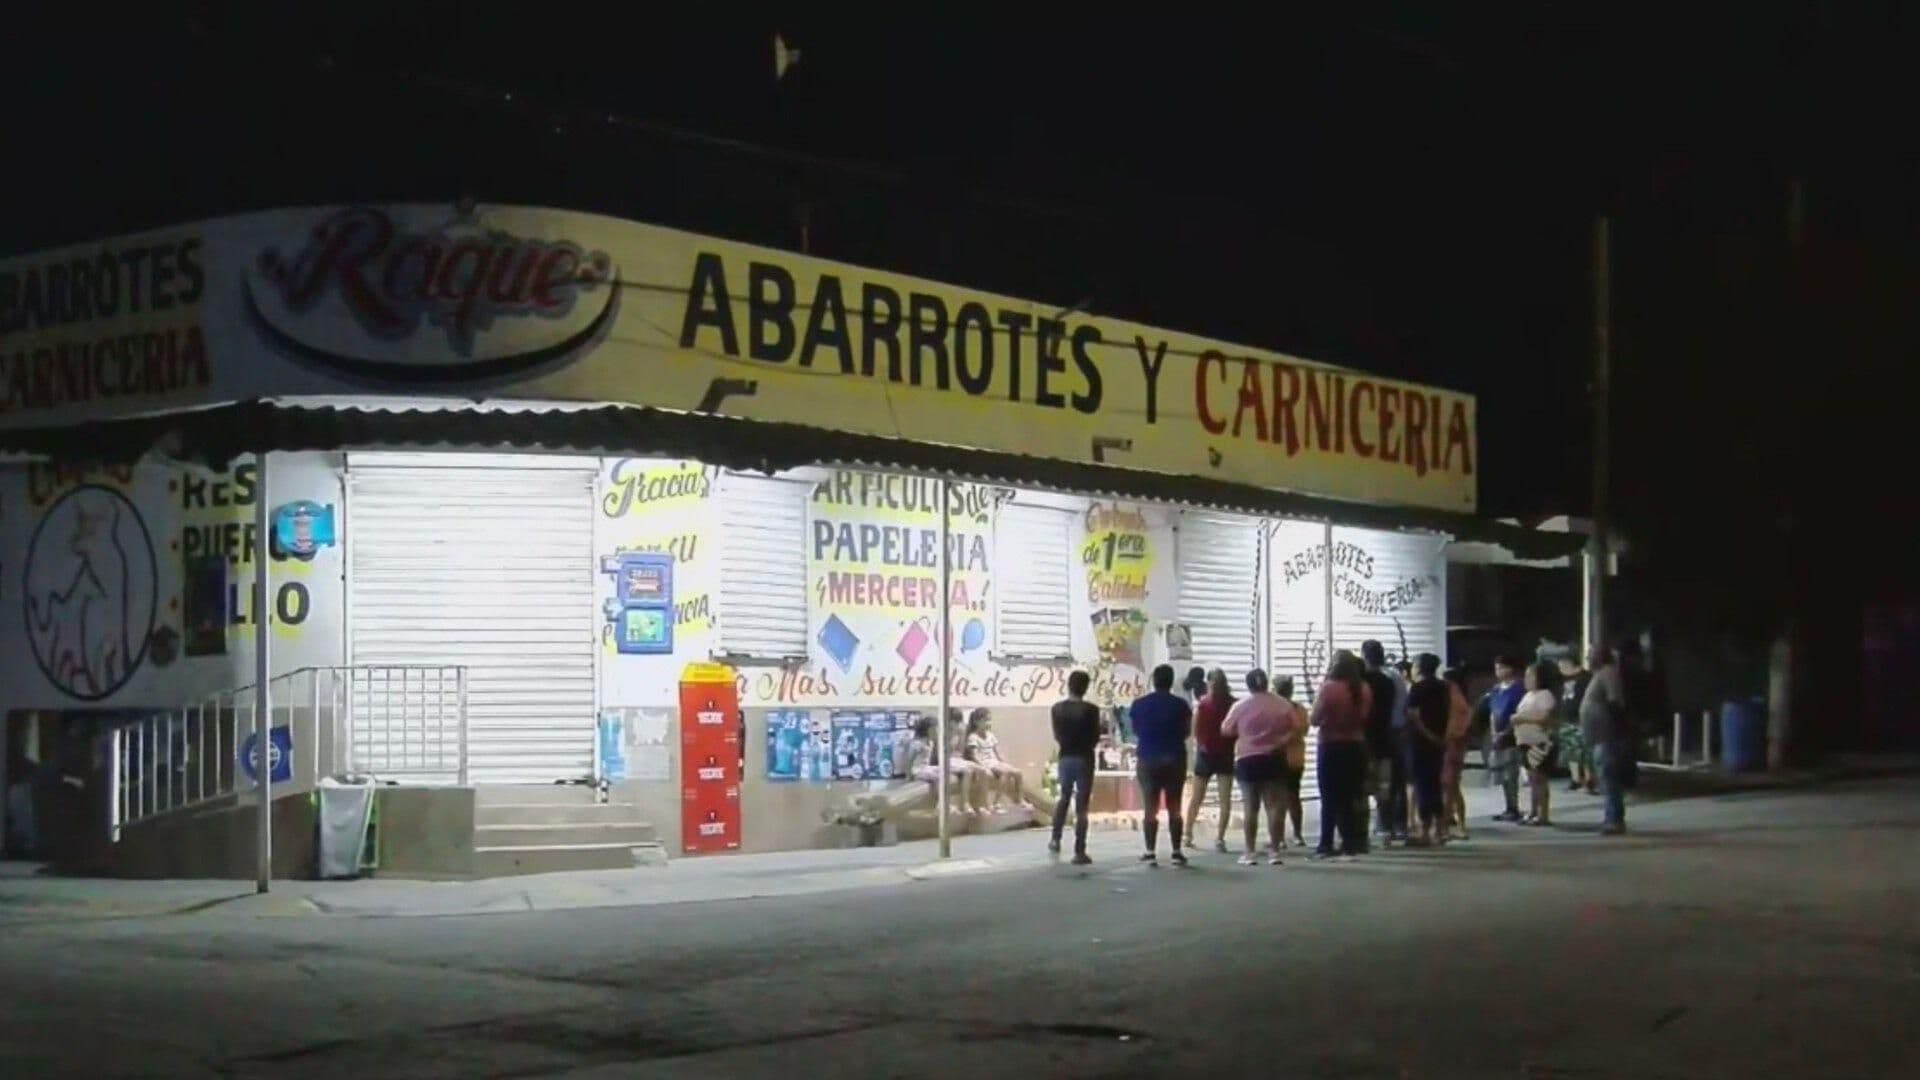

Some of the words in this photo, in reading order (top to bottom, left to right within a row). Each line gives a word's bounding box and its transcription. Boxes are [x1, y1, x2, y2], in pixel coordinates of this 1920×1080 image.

[679, 252, 1103, 415] ABARROTES
[1135, 335, 1168, 424] Y
[1195, 350, 1473, 478] CARNICERIA
[1284, 541, 1374, 584] ABAROTES
